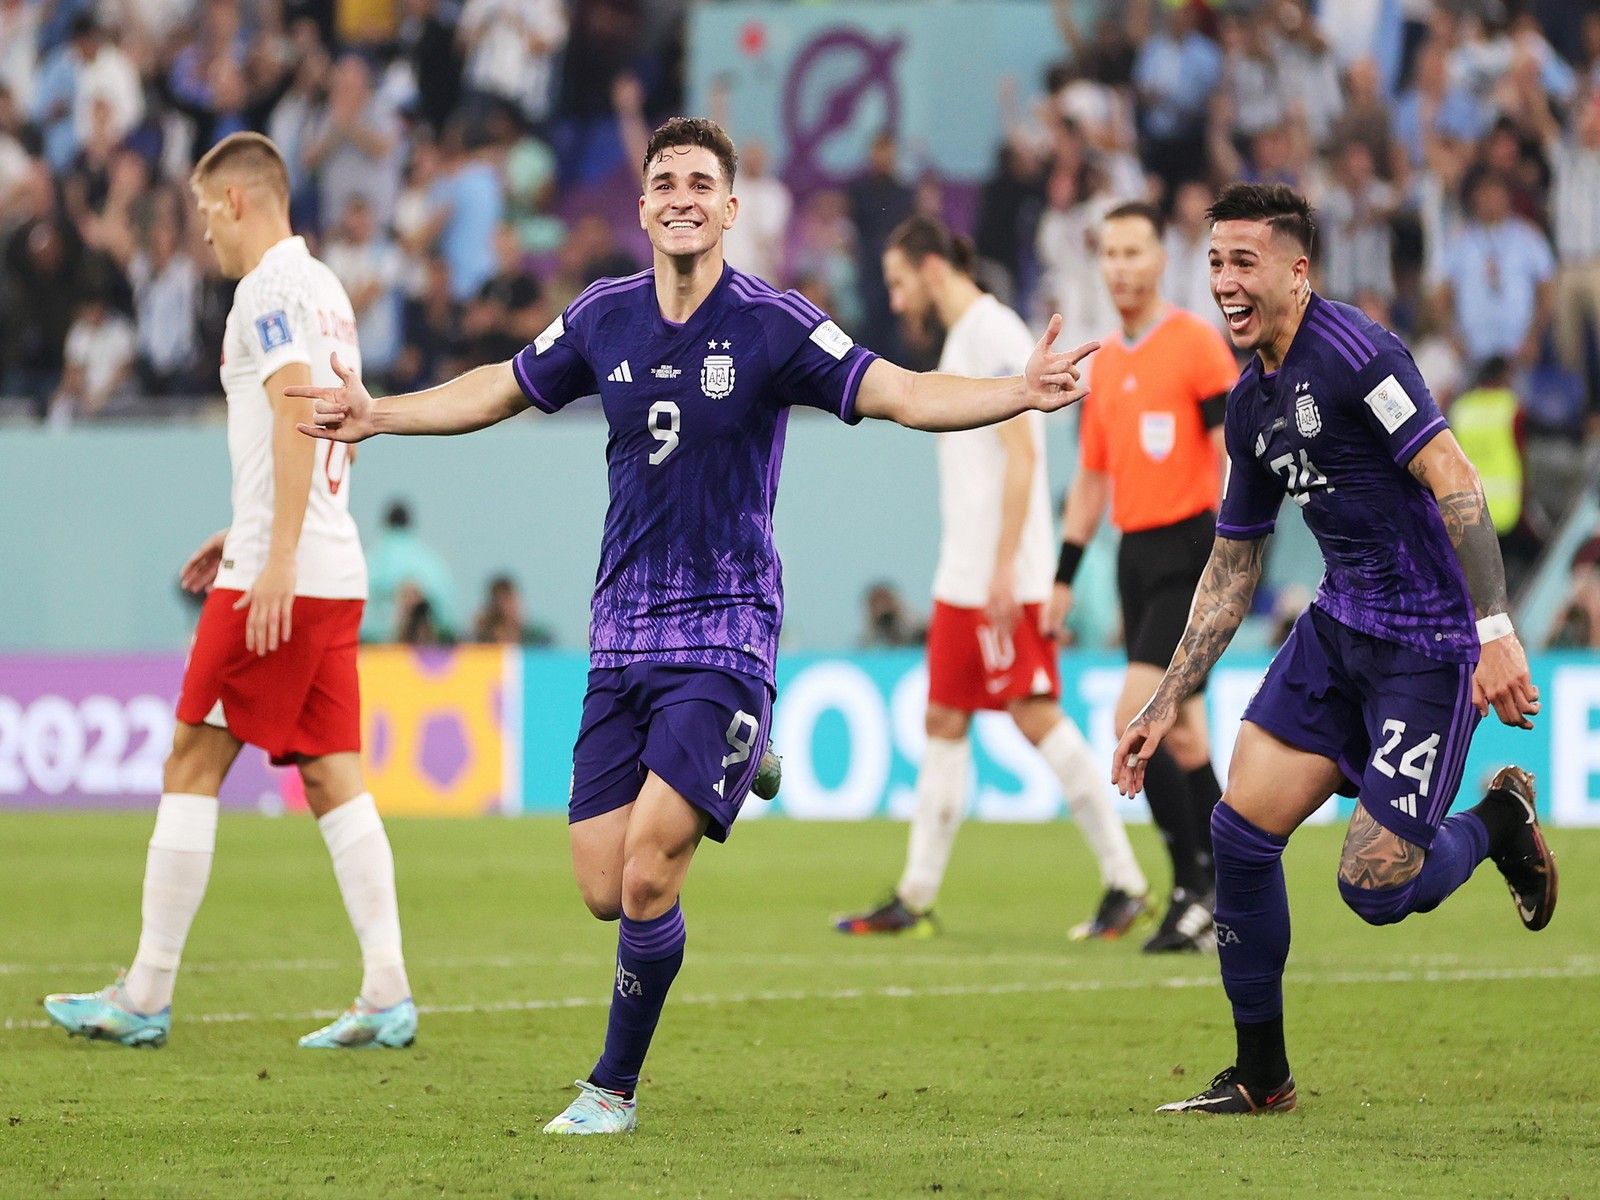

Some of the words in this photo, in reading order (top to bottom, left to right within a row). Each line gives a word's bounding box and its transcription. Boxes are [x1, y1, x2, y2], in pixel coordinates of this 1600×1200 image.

[709, 366, 727, 387] AFA
[647, 400, 681, 466] 9
[1269, 447, 1336, 507] 24
[0, 692, 175, 796] 2022
[719, 708, 760, 770] 9
[1371, 718, 1441, 798] 24
[1213, 920, 1242, 947] FA
